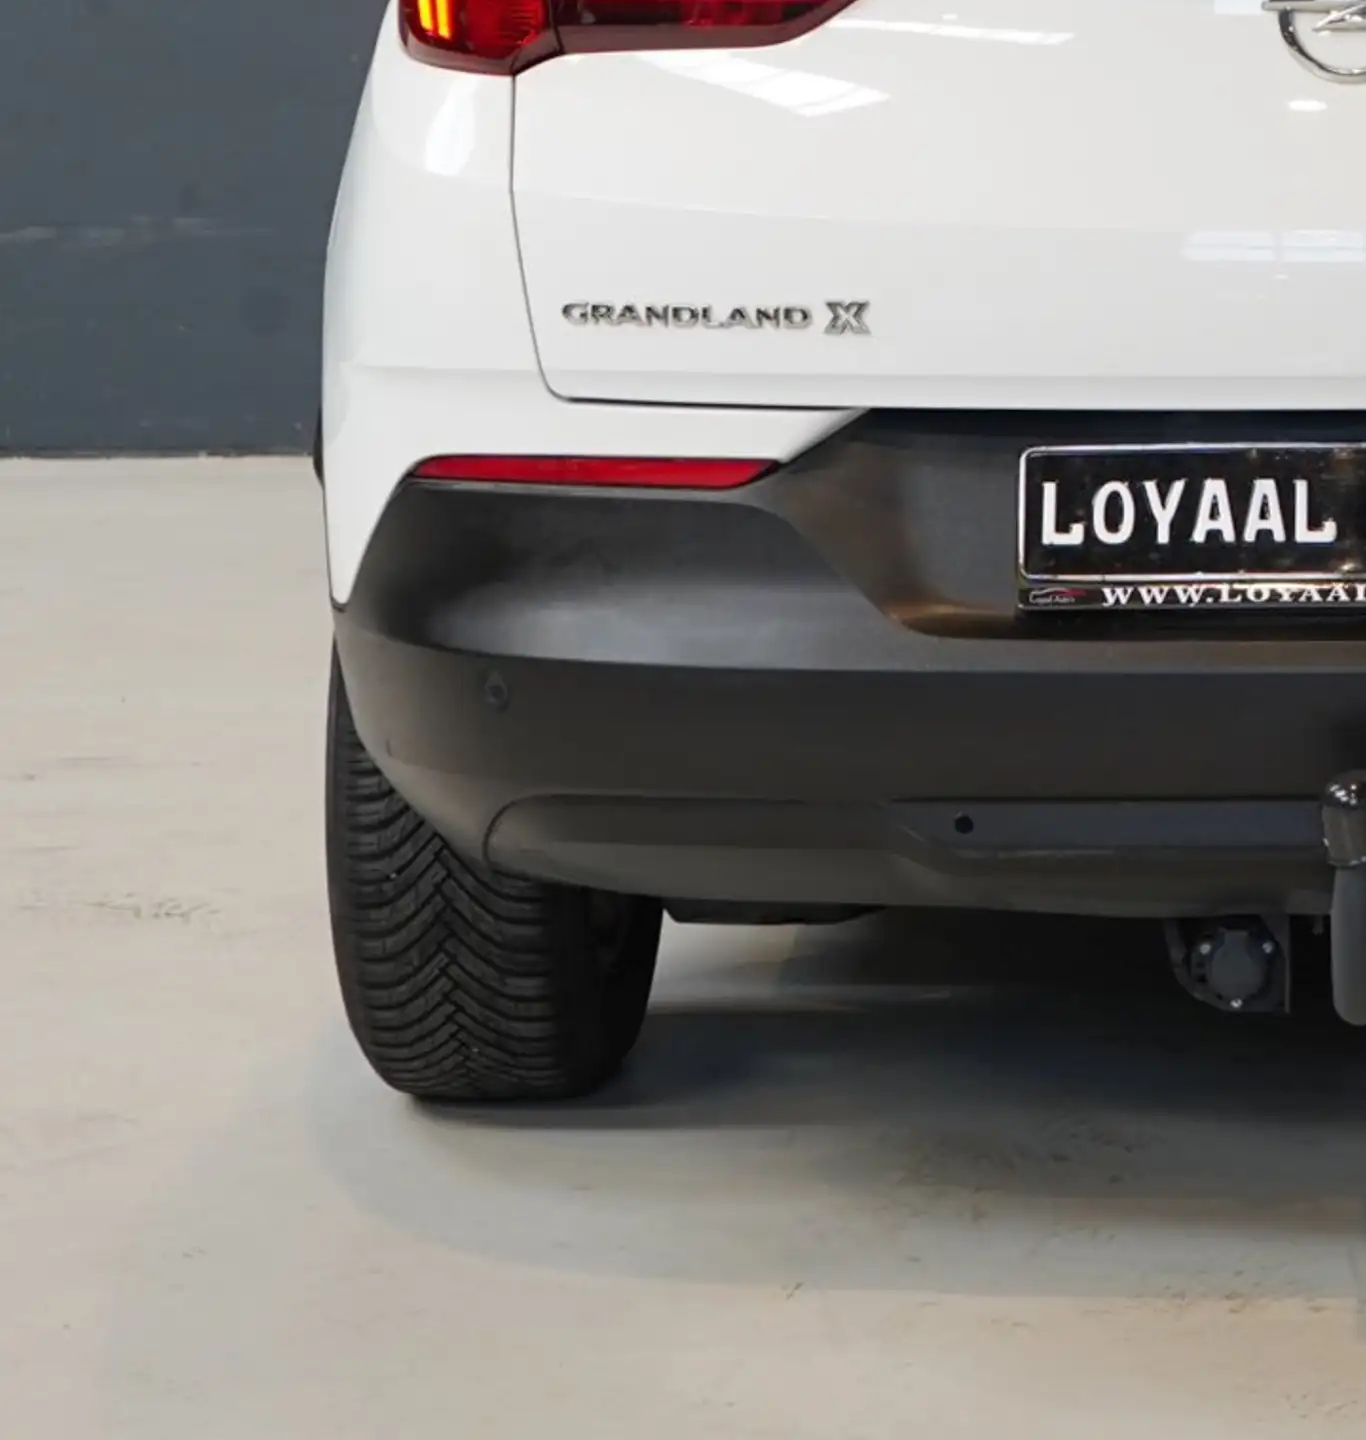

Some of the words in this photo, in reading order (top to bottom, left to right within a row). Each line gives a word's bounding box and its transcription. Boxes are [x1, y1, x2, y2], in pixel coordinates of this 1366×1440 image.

[561, 302, 813, 329] GRANDLAND
[824, 301, 871, 335] X
[1042, 477, 1337, 545] LOYAAL
